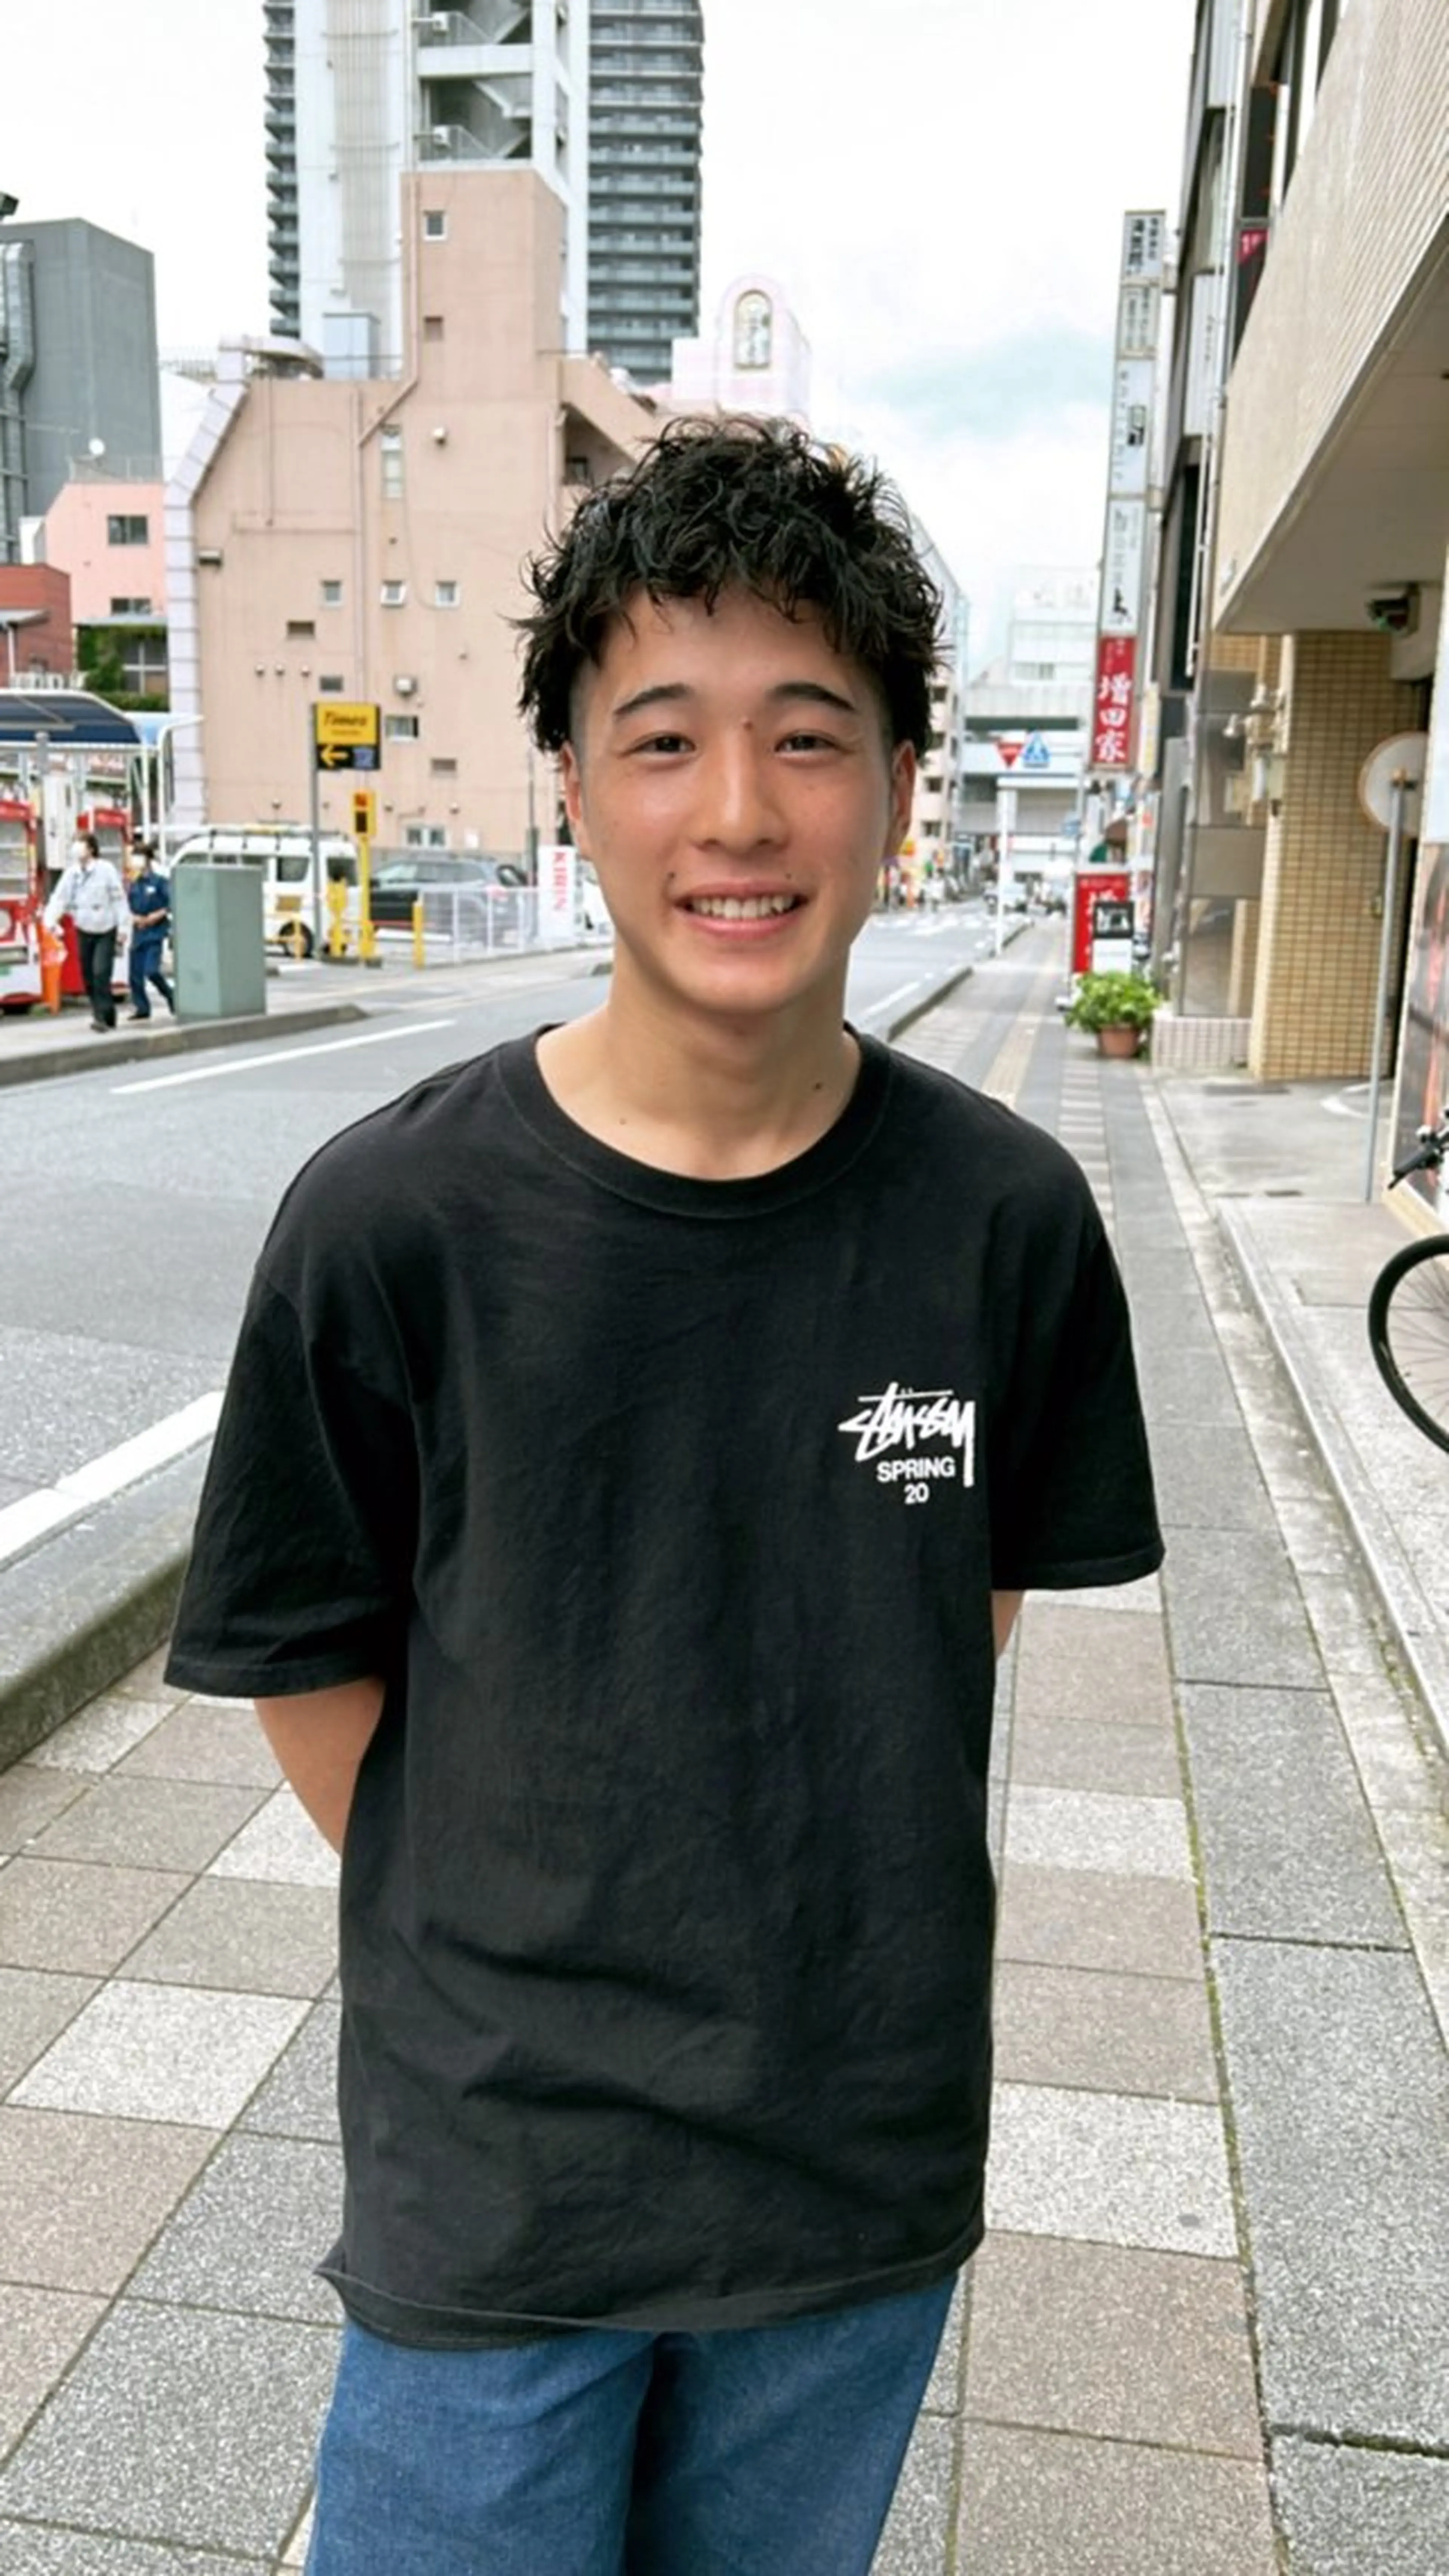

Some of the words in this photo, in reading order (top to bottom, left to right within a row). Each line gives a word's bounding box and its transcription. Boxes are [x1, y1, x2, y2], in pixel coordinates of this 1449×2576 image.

[1096, 672, 1131, 761] 増田家
[877, 1456, 956, 1482] SPRING
[904, 1482, 929, 1504] 20
